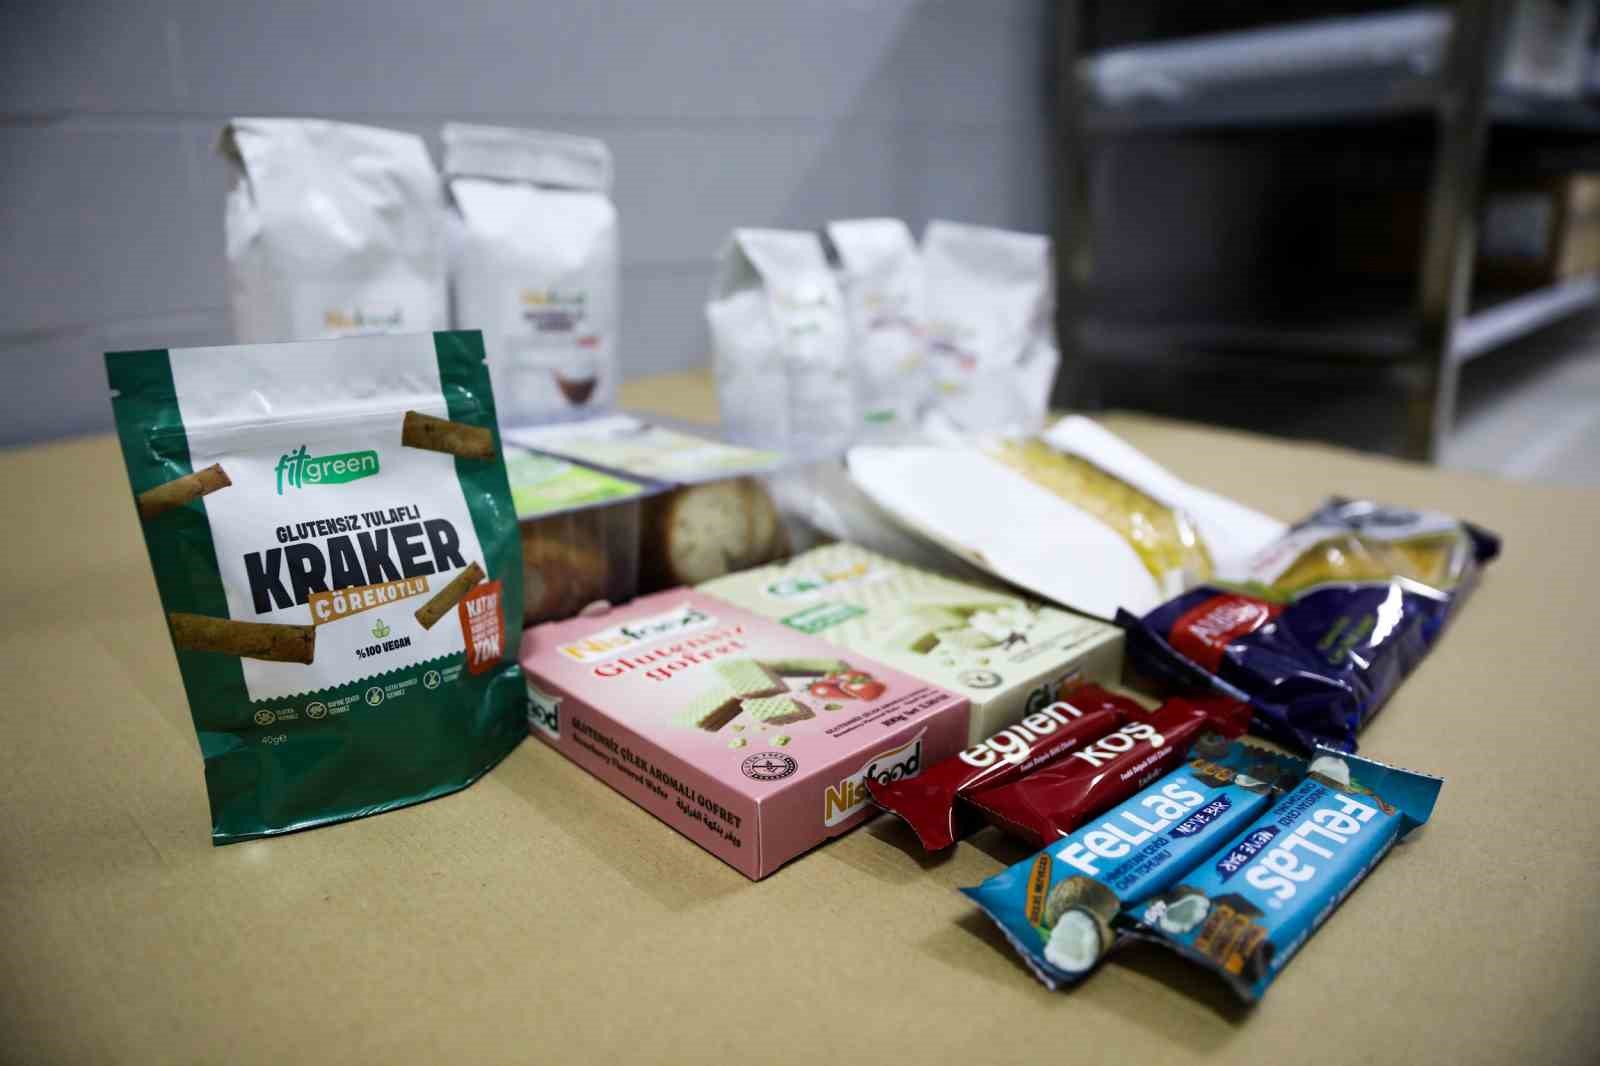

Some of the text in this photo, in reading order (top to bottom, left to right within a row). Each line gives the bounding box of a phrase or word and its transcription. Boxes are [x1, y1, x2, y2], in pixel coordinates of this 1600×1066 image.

[362, 504, 420, 529] YULAFLI
[243, 518, 466, 615] KRAKER
[316, 576, 424, 622] ÇÖREKOTLU
[355, 636, 411, 660] %100 VEGAN
[649, 764, 695, 802] AROMALI
[697, 793, 742, 829] GOFRET
